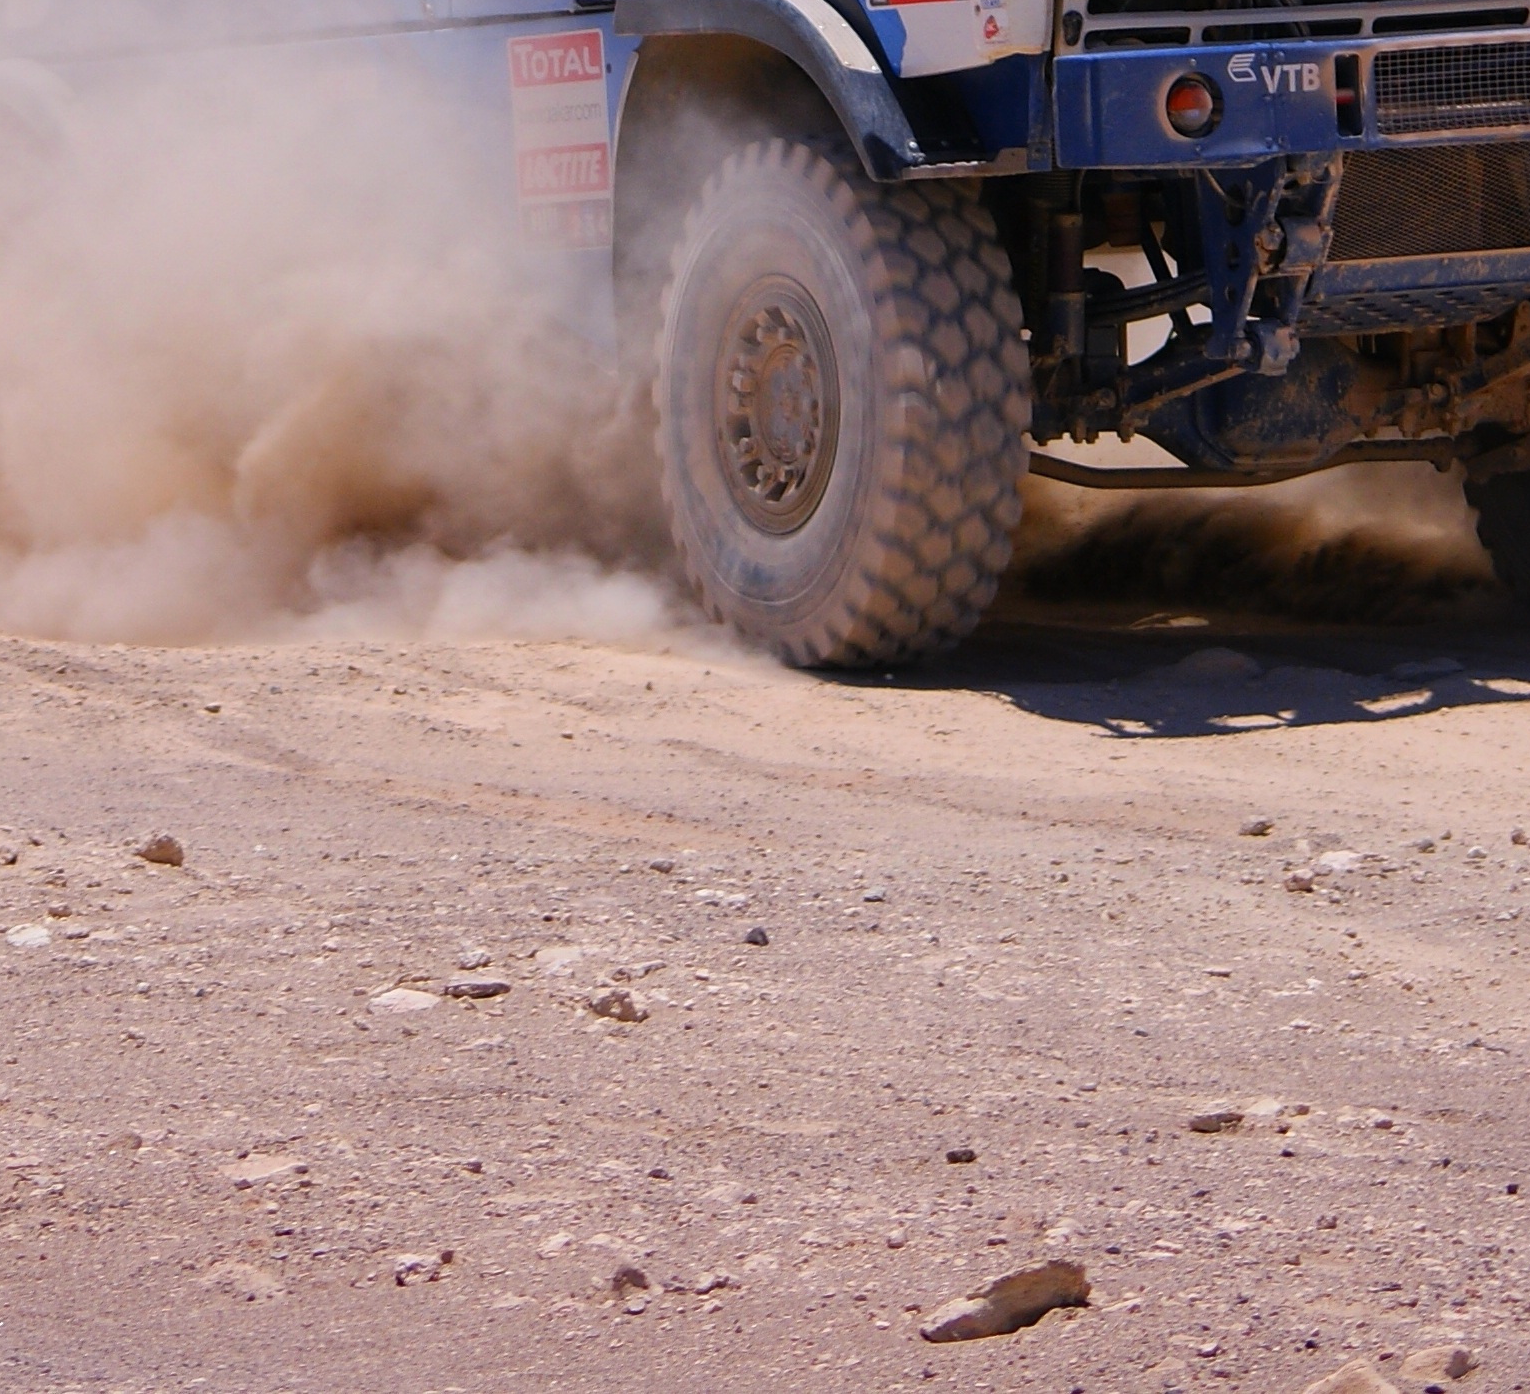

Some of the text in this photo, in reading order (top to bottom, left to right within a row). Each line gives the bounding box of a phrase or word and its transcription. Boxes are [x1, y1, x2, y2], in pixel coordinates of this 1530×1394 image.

[513, 44, 600, 80] TOTAL
[1261, 63, 1321, 93] VTB
[524, 150, 601, 188] LOCTITE
